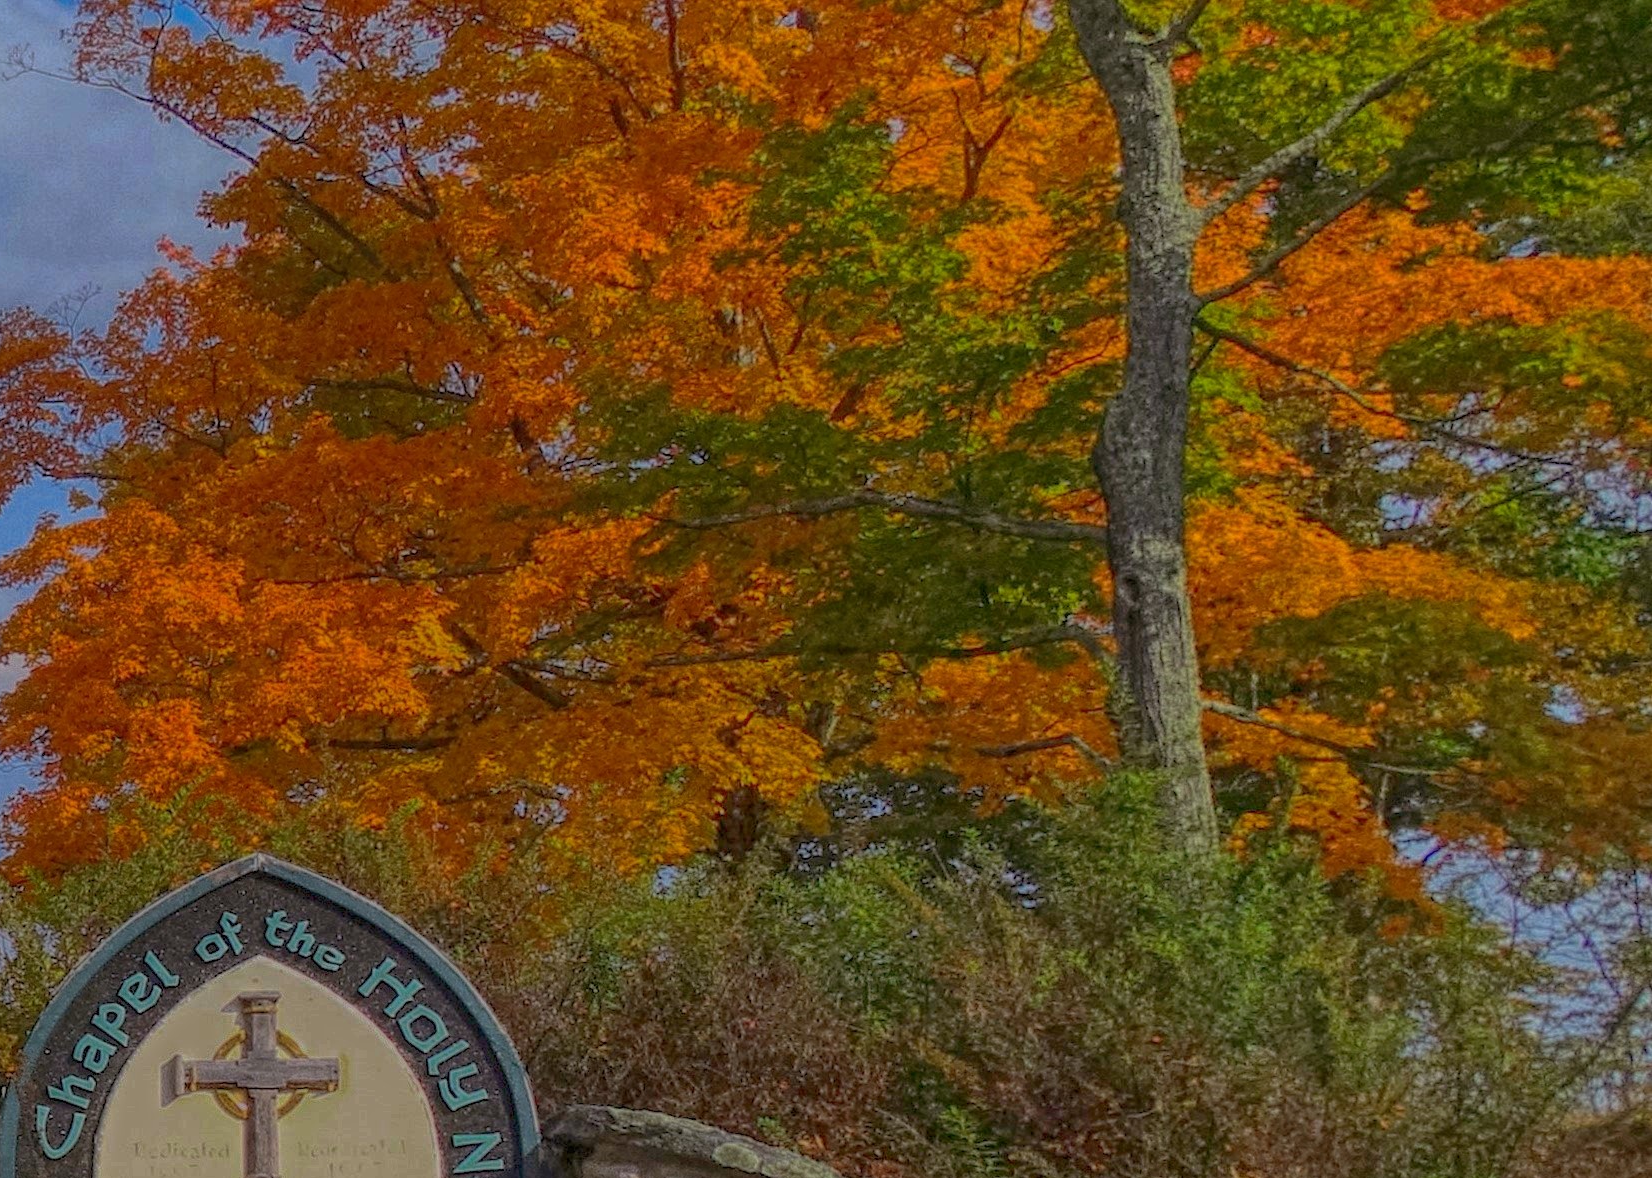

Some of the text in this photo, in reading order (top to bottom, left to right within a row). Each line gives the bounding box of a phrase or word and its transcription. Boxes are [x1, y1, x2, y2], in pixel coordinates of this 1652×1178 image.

[36, 949, 181, 1161] Chapel
[196, 911, 242, 962] of
[264, 909, 347, 973] the
[358, 956, 490, 1113] Holy
